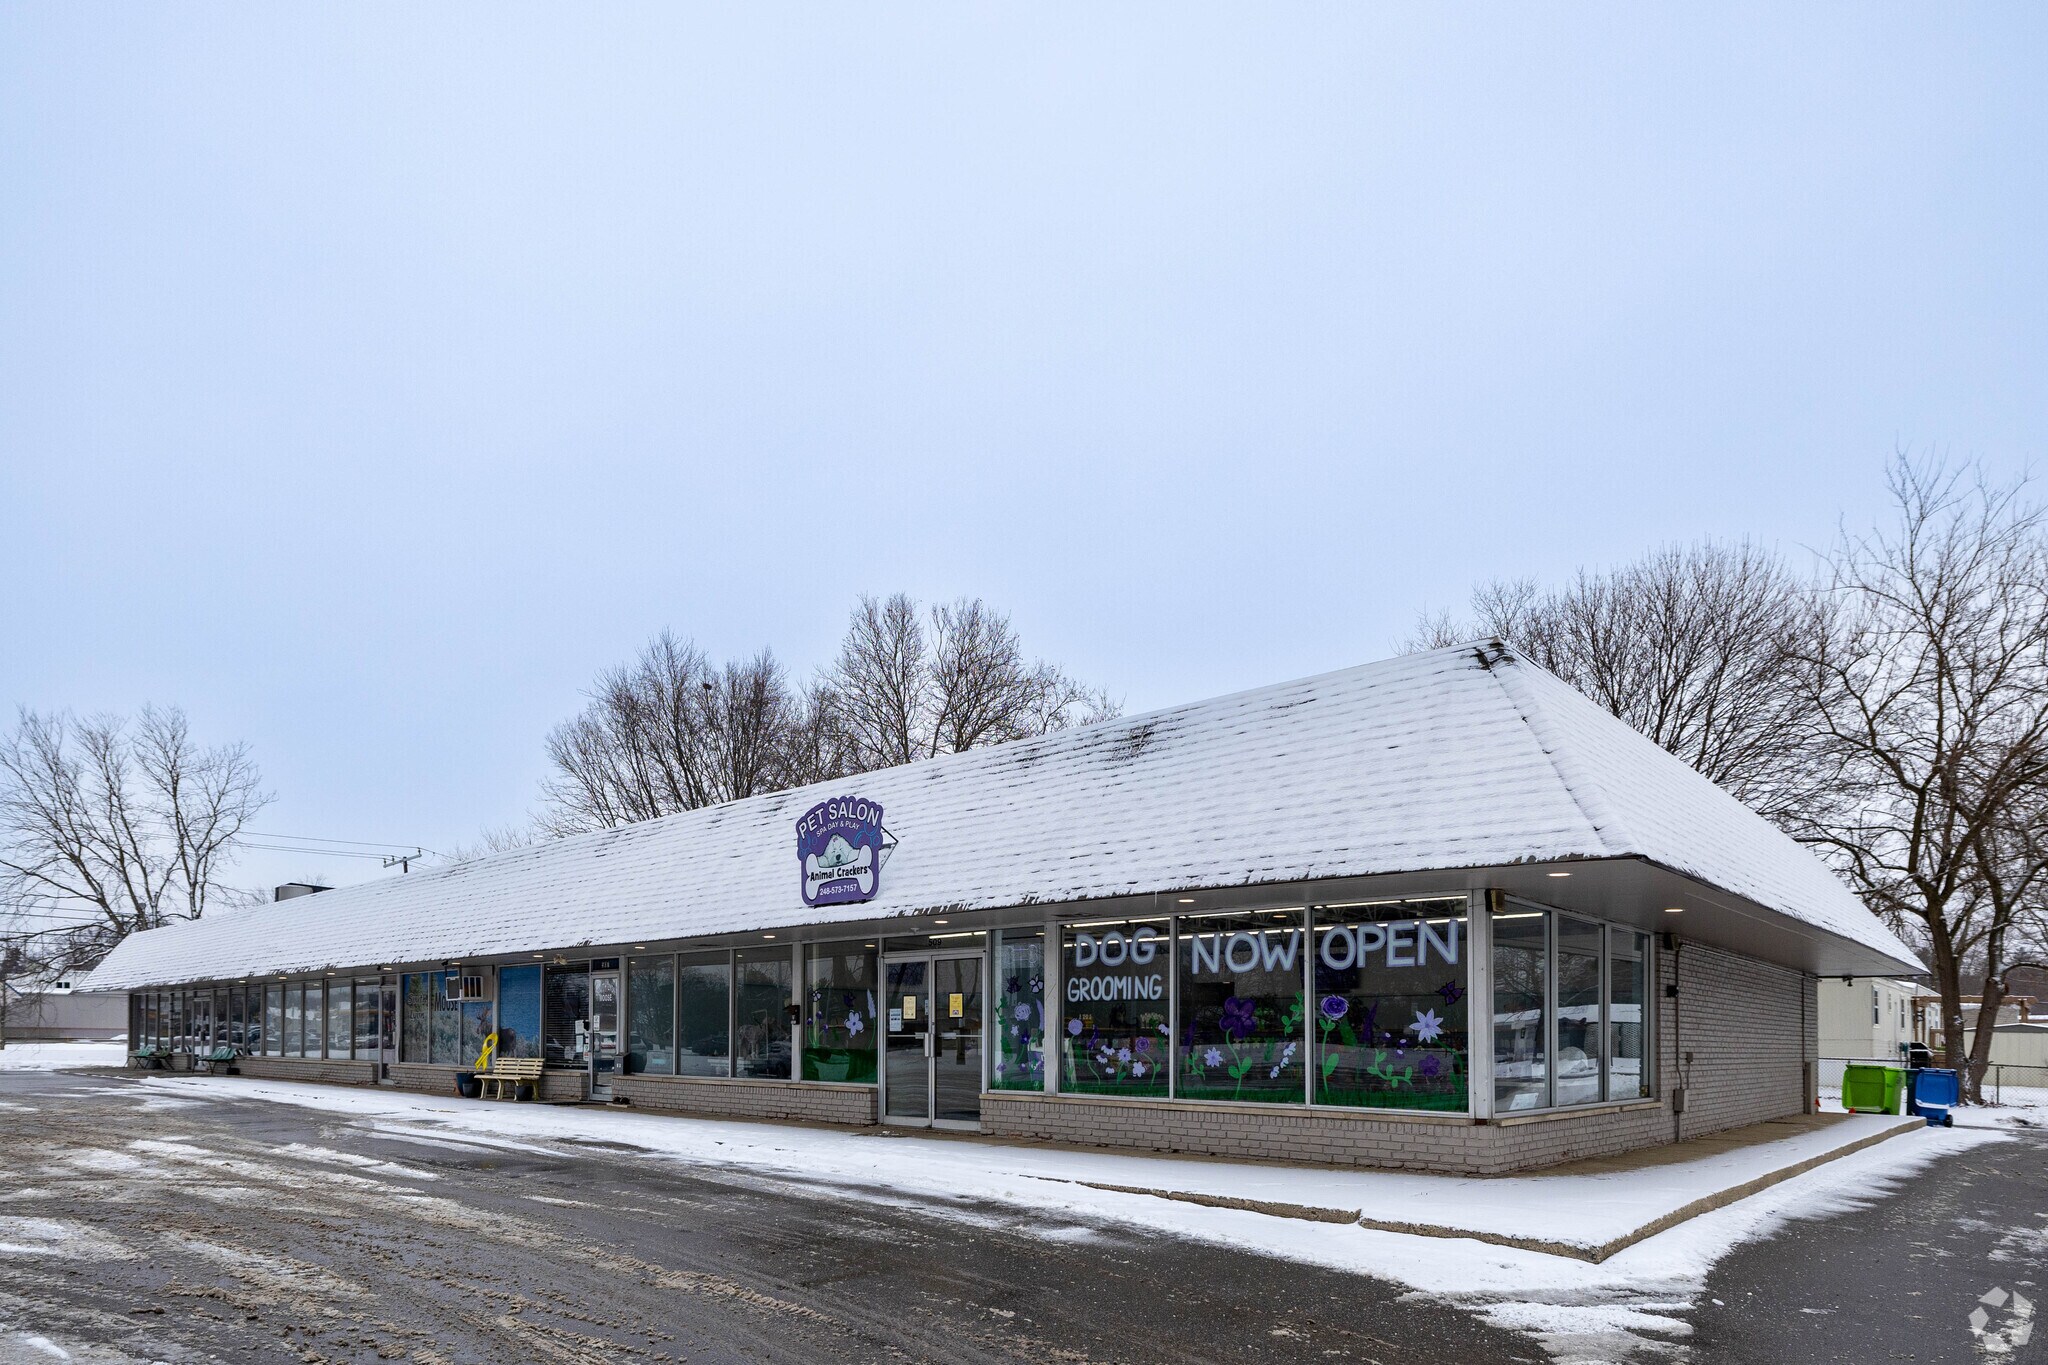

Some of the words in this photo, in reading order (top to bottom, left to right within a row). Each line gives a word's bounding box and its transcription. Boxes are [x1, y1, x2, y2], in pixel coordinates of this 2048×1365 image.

[799, 808, 824, 839] PET
[829, 802, 879, 826] SALON
[816, 829, 827, 837] SPA
[828, 821, 838, 830] DAY
[845, 821, 860, 829] PLAY
[810, 870, 835, 882] Animal
[837, 866, 867, 877] Crackers
[819, 884, 857, 896] 248-573-7157
[928, 938, 942, 946] 509
[1076, 927, 1157, 967] DOG
[1191, 928, 1301, 974] NOW
[1320, 919, 1458, 970] OPEN
[1067, 973, 1163, 1003] GROOMING
